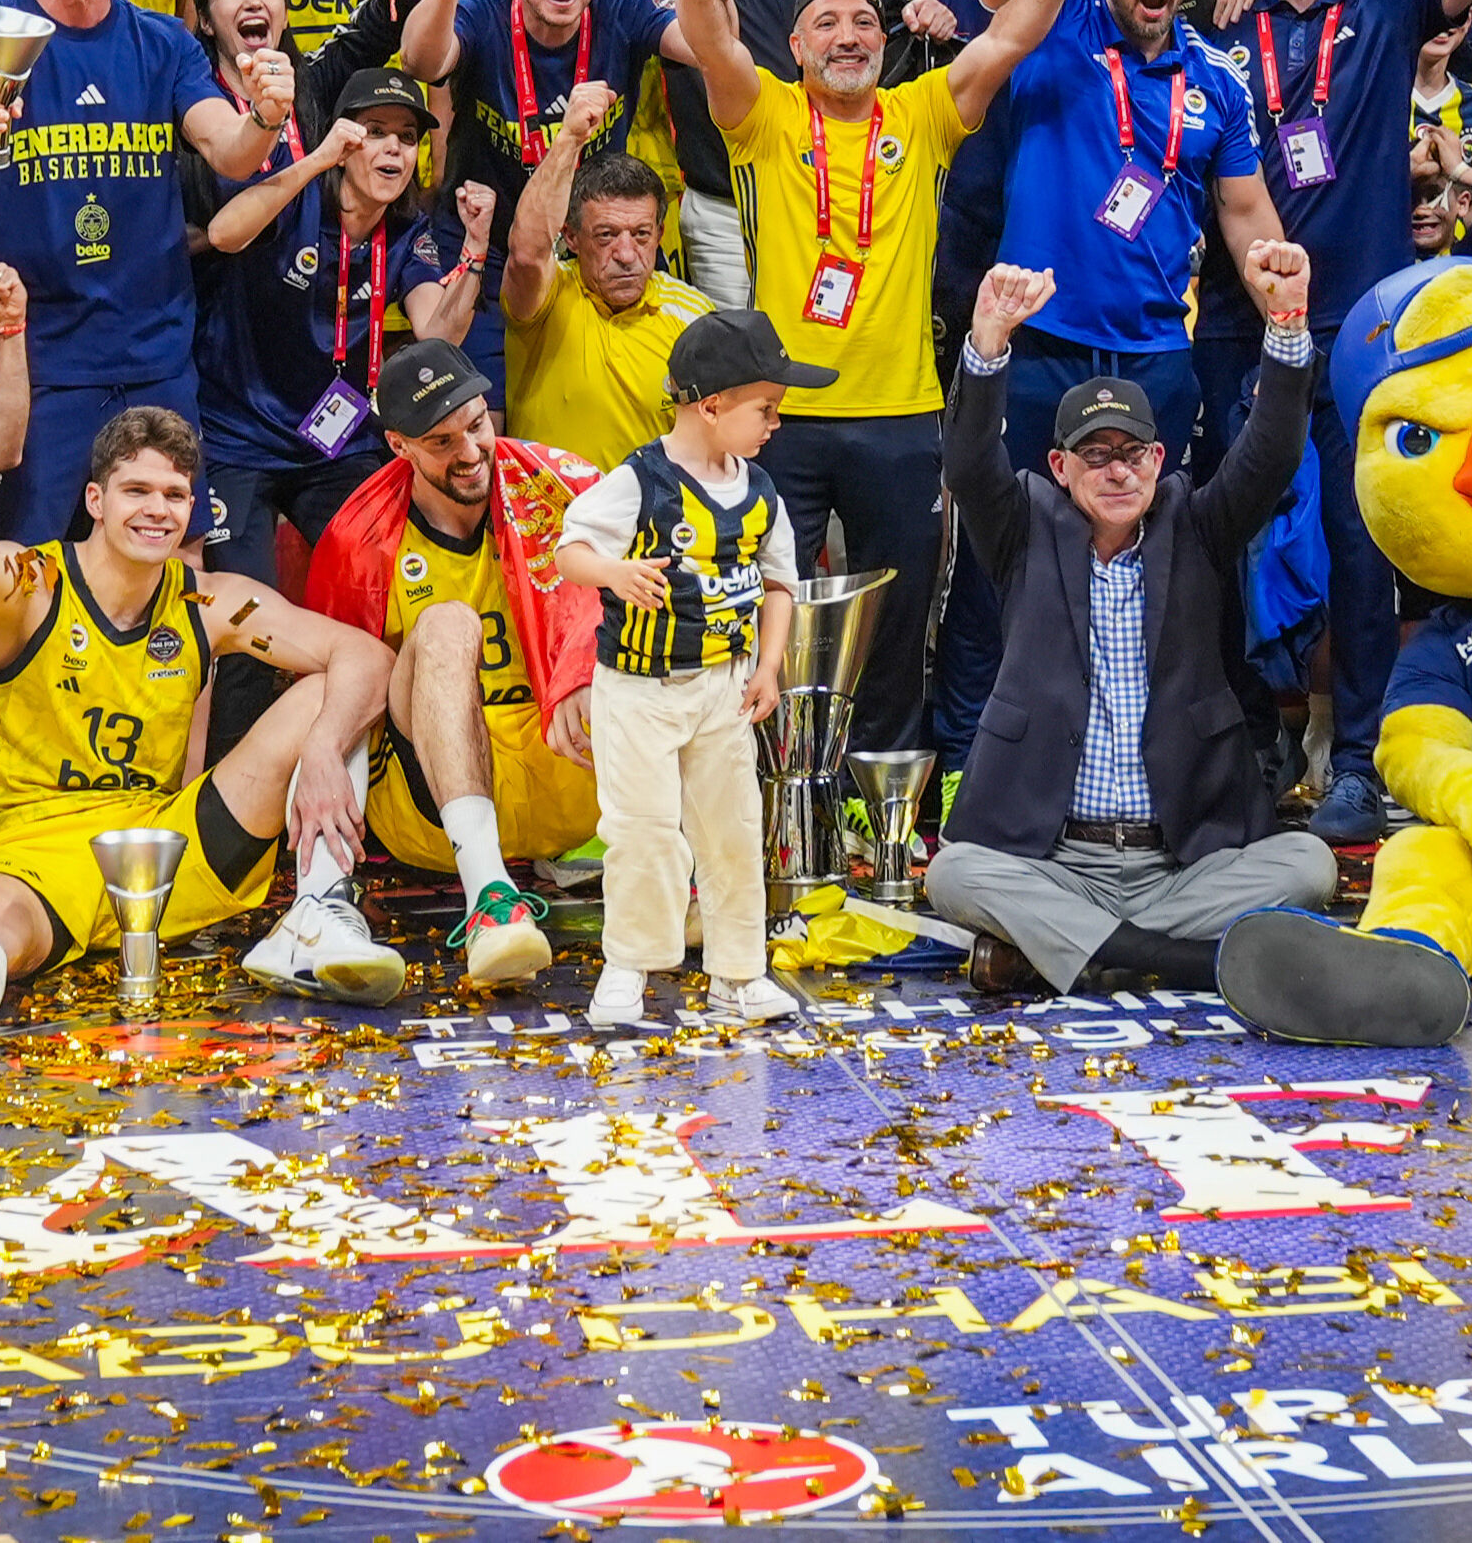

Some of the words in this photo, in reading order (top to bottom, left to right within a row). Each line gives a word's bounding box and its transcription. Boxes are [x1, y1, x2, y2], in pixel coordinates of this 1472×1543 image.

[9, 122, 173, 162] ENERBAHÇ
[19, 155, 162, 186] BASKETBALL
[76, 242, 111, 257] beko
[287, 269, 310, 288] beko
[412, 372, 454, 402] CHAMPIONS
[1081, 402, 1131, 416] CHAMPIONS
[405, 584, 434, 598] beko
[62, 653, 88, 667] beko
[81, 706, 144, 766] 13
[581, 1258, 1466, 1354] DHABI
